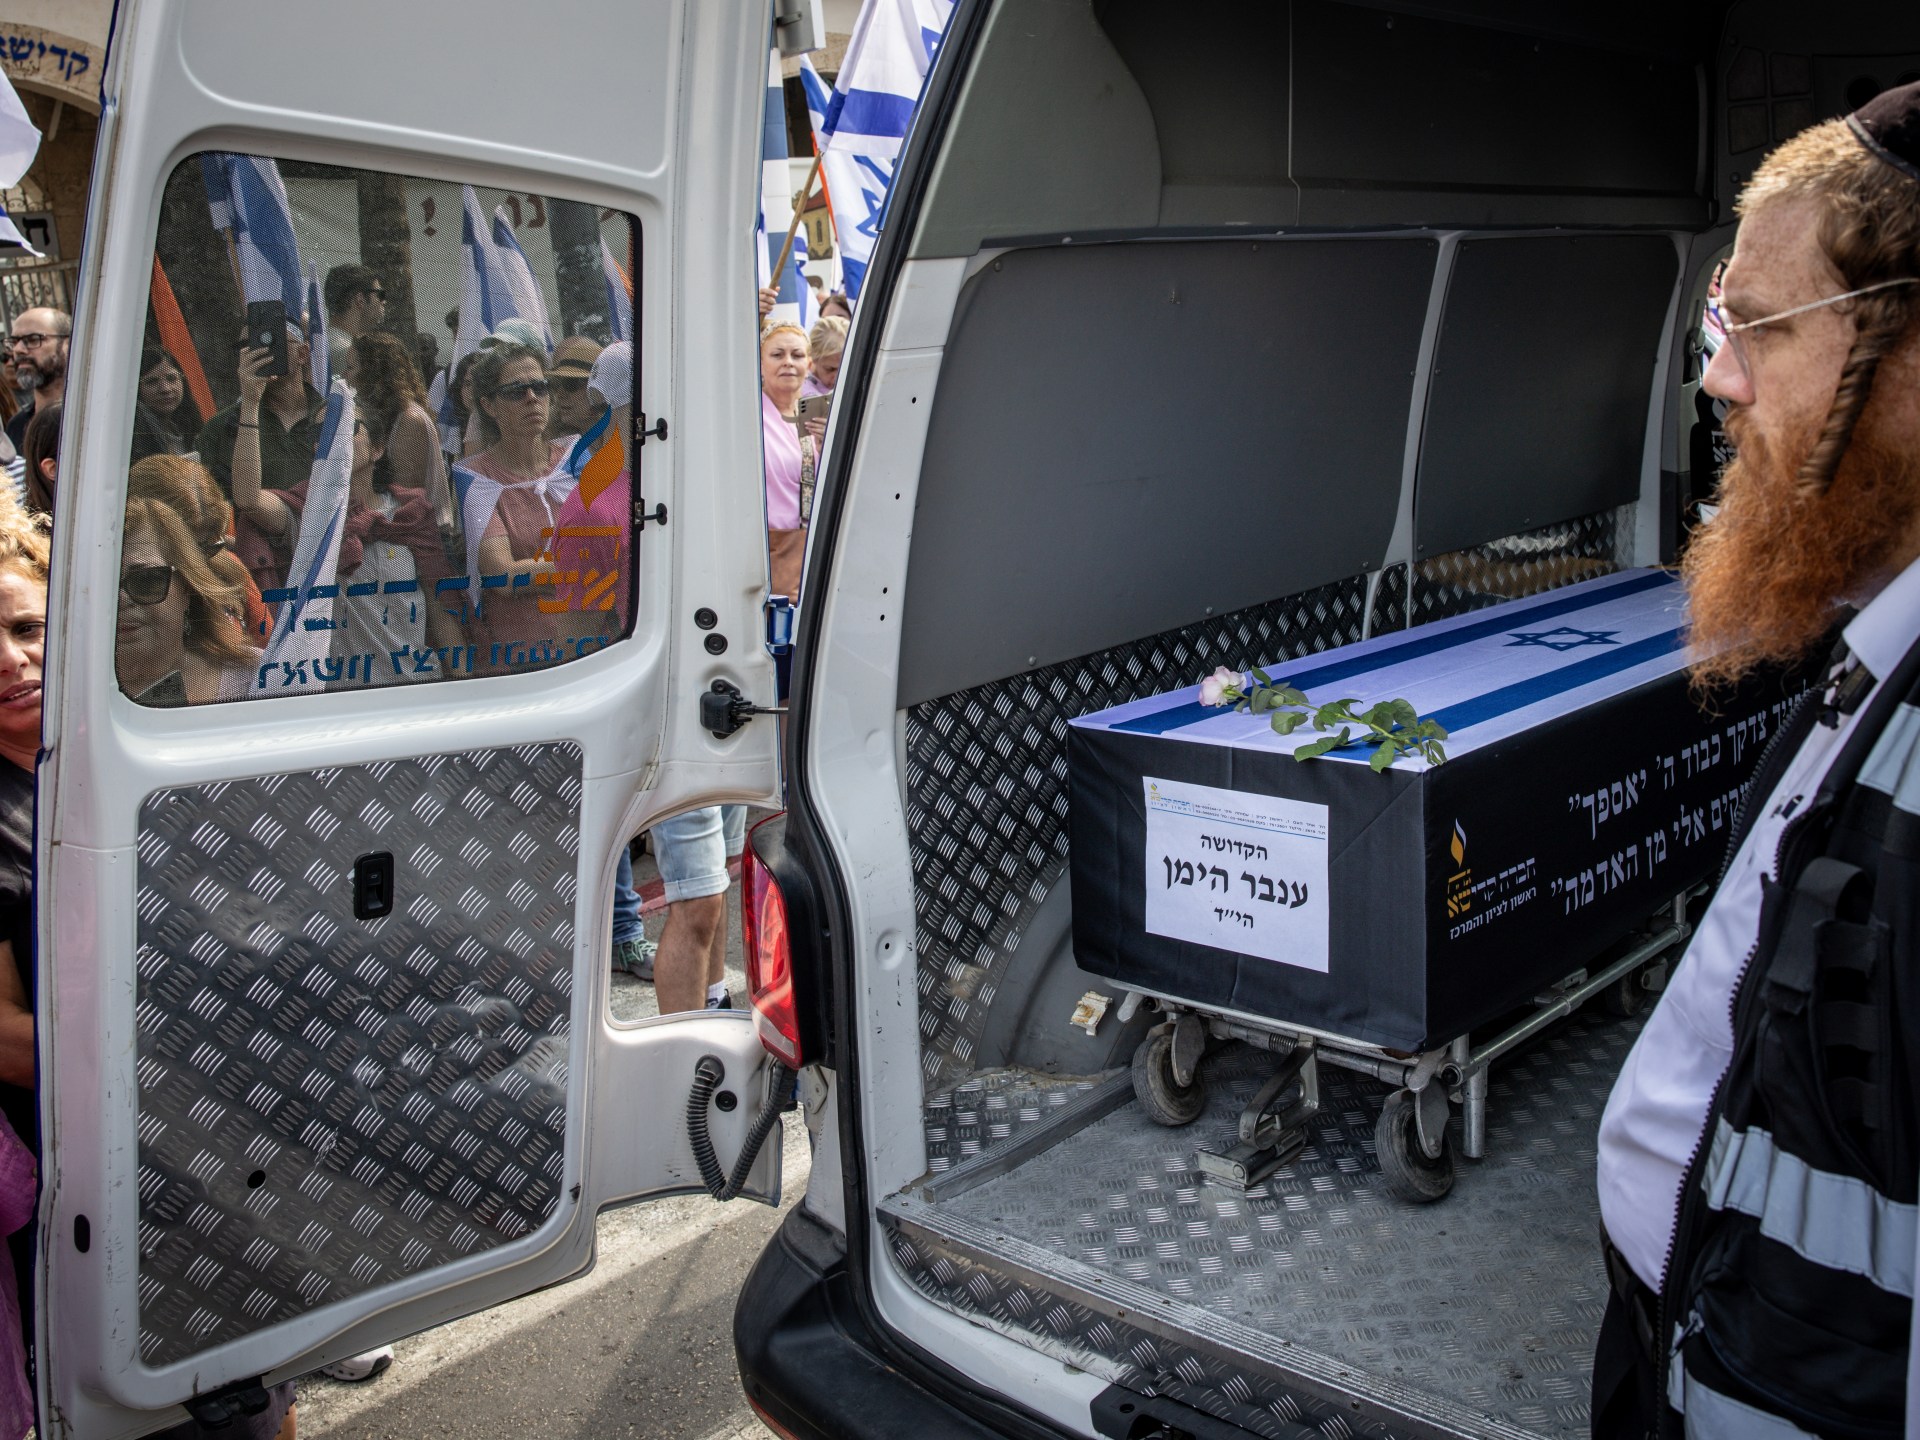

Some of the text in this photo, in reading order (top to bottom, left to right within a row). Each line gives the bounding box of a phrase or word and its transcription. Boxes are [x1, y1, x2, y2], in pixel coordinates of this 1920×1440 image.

[1681, 733, 1721, 778] כבוד
[1727, 710, 1767, 766] צדקך
[1200, 834, 1268, 861] הקדושה
[1673, 804, 1706, 847] אלי
[1646, 829, 1667, 880] מן
[1163, 855, 1309, 909] ענבר הימן
[1450, 886, 1537, 940] ראשון לציון והמרכז
